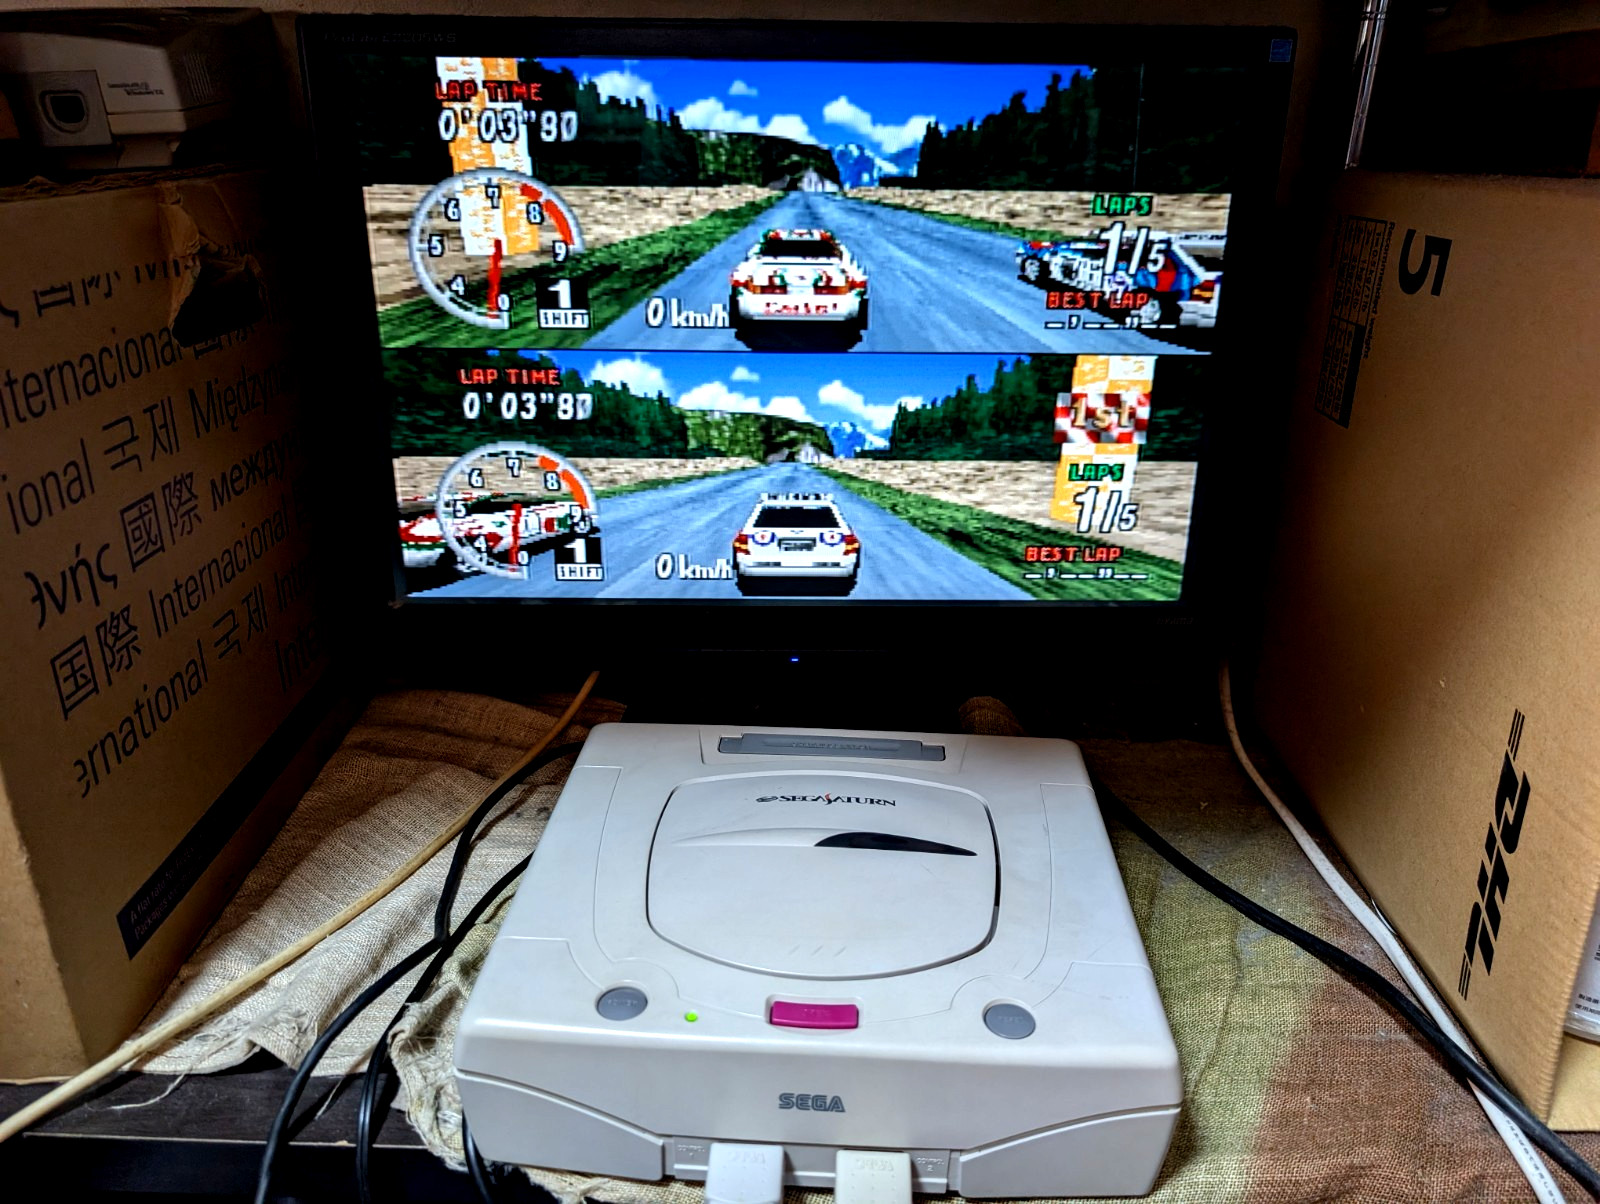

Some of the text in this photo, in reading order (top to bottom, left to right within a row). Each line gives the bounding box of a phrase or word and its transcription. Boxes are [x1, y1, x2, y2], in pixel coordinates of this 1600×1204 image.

[435, 82, 542, 101] LAP TIME
[446, 202, 459, 220] 6
[528, 203, 541, 223] 8
[1094, 196, 1150, 215] LAPS
[430, 235, 442, 256] 5
[1398, 229, 1452, 297] 5
[548, 279, 571, 308] 1
[1047, 292, 1101, 308] BEST
[647, 296, 729, 328] 0 km/h
[0, 327, 184, 430] ternaciona
[459, 369, 560, 385] LAP TIME
[101, 396, 181, 472] 국제
[509, 459, 519, 475] 7
[1070, 465, 1124, 480] LAPS
[471, 470, 482, 487] 6
[546, 472, 558, 489] 8
[119, 471, 203, 573] 國際
[564, 538, 587, 563] 1
[1025, 547, 1120, 562] BEST LAP
[656, 554, 733, 579] 0 km/h
[50, 494, 290, 721] 国際 Internacional
[212, 583, 268, 660] 국제
[1463, 749, 1531, 977] DHL
[778, 1092, 846, 1112] SEGA
